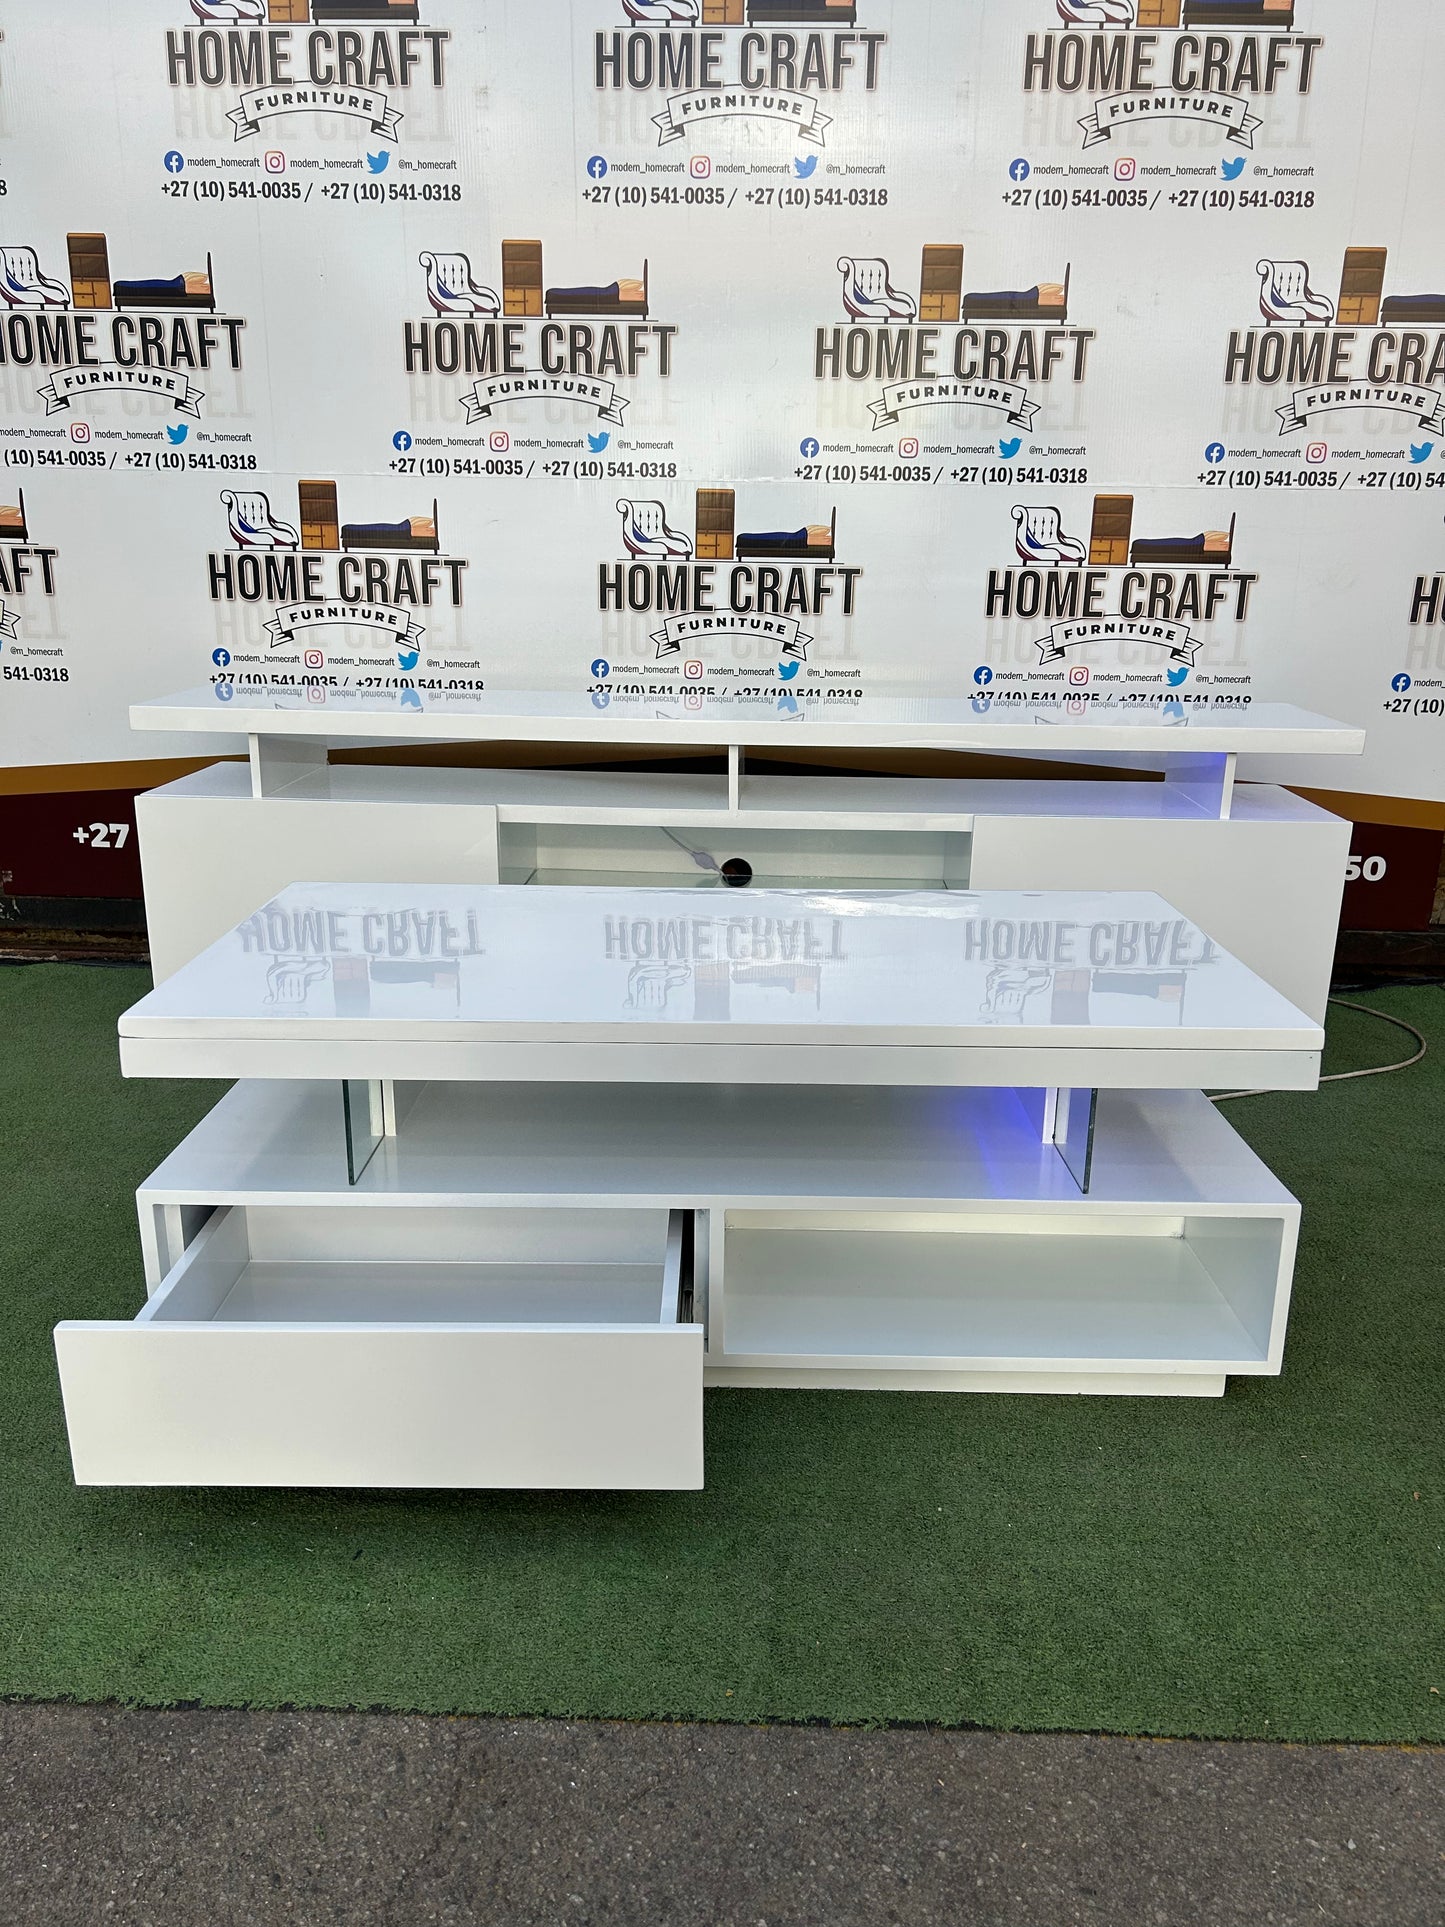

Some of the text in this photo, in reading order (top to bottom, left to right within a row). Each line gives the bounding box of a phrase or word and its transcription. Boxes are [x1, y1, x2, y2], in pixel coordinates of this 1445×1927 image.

[165, 29, 450, 87] HOME CRAFT
[594, 30, 886, 90] HOME CRAFT
[1022, 33, 1323, 94] HOME CRAFT
[254, 91, 374, 113] FURNITURE
[681, 94, 804, 116] FURNITURE
[1109, 96, 1234, 118] FURNITURE
[397, 158, 458, 172] @m_homecraft
[825, 163, 887, 176] @m_homecraft
[1252, 165, 1315, 178] @m_homecraft
[161, 180, 189, 198] +27
[193, 180, 225, 202] (10)
[228, 181, 302, 199] 541-0035
[320, 182, 350, 200] +27
[353, 183, 385, 204] (10)
[388, 183, 462, 202] 541-0318
[582, 186, 611, 203] +27
[615, 186, 647, 208] (10)
[650, 186, 725, 205] 541-0035
[745, 188, 775, 205] +27
[778, 188, 810, 209] (10)
[813, 188, 888, 206] 541-0318
[1002, 189, 1032, 206] +27
[1035, 189, 1068, 210] (10)
[1071, 189, 1148, 207] 541-0035
[1168, 189, 1199, 207] +27
[1201, 190, 1235, 212] (10)
[1238, 190, 1315, 208] 541-0318
[0, 313, 245, 370] OME CRAFT
[403, 321, 677, 377] HOME CRAFT
[814, 326, 1095, 382] HOME CRAFT
[1223, 330, 1445, 385] HOME CRA
[63, 371, 176, 391] FURNITURE
[487, 379, 601, 399] FURNITURE
[896, 384, 1013, 404] FURNITURE
[1306, 388, 1426, 408] FURNITURE
[195, 431, 253, 444] @m_homecraft
[616, 439, 675, 451] @m_homecraft
[4, 449, 35, 468] (10)
[37, 449, 107, 467] 541-0035
[124, 451, 152, 468] +27
[155, 452, 186, 472] (10)
[188, 453, 257, 470] 541-0318
[1028, 445, 1087, 457] @m_homecraft
[388, 457, 416, 473] +27
[419, 458, 450, 478] (10)
[453, 458, 524, 476] 541-0035
[542, 460, 570, 476] +27
[573, 461, 604, 480] (10)
[607, 461, 677, 478] 541-0318
[794, 464, 823, 480] +27
[825, 465, 856, 484] (10)
[859, 465, 931, 482] 541-0035
[950, 466, 979, 482] +27
[981, 466, 1013, 486] (10)
[1016, 467, 1088, 484] 541-0318
[1197, 469, 1227, 486] +27
[1228, 470, 1261, 490] (10)
[1263, 470, 1338, 487] 541-0035
[1357, 471, 1388, 488] +27
[1389, 471, 1422, 491] (10)
[207, 552, 468, 607] HOME CRAFT
[598, 562, 862, 615] HOME CRAFT
[984, 569, 1258, 621] HOME CRAFT
[289, 607, 398, 626] FURNITURE
[677, 617, 787, 636] FURNITURE
[1063, 623, 1177, 641] FURNITURE
[9, 645, 64, 657] @m_homecraft
[3, 665, 70, 682] 541-0318
[425, 658, 481, 671] @m_homecraft
[806, 668, 862, 679] @m_homecraft
[1195, 674, 1252, 685] @m_homecraft
[648, 685, 715, 696] 5410035
[796, 688, 863, 698] 5410318
[1031, 691, 1100, 702] 5410035
[1383, 698, 1445, 717] +27 (10)
[73, 822, 130, 849] +27
